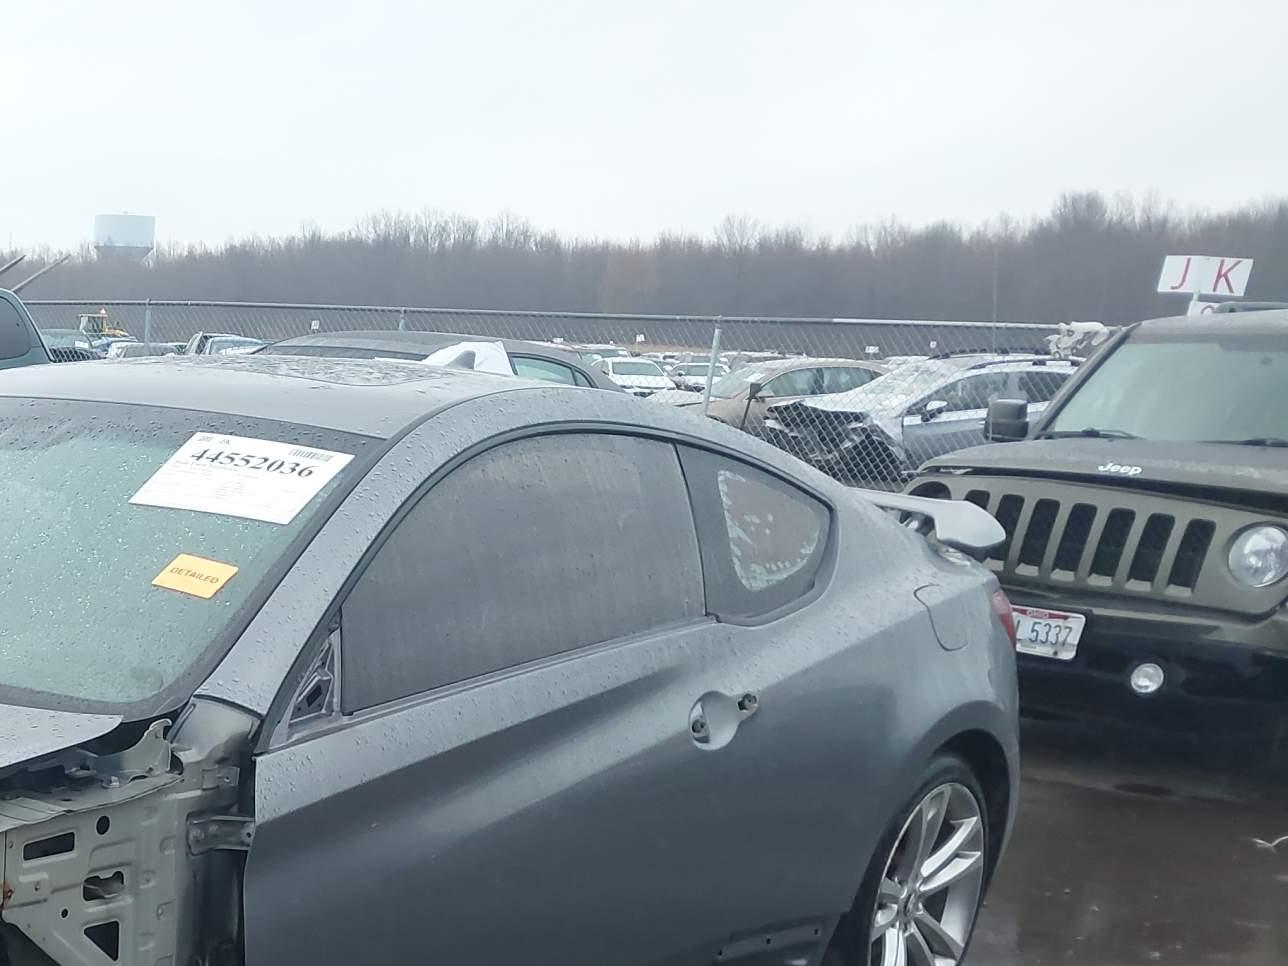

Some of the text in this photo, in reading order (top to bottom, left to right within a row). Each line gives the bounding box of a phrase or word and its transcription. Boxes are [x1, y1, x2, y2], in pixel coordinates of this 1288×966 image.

[1170, 257, 1243, 293] J K
[190, 448, 320, 478] 44552036
[1098, 463, 1142, 475] Jeep
[169, 567, 219, 584] DETAILED
[1029, 621, 1072, 647] 5337
